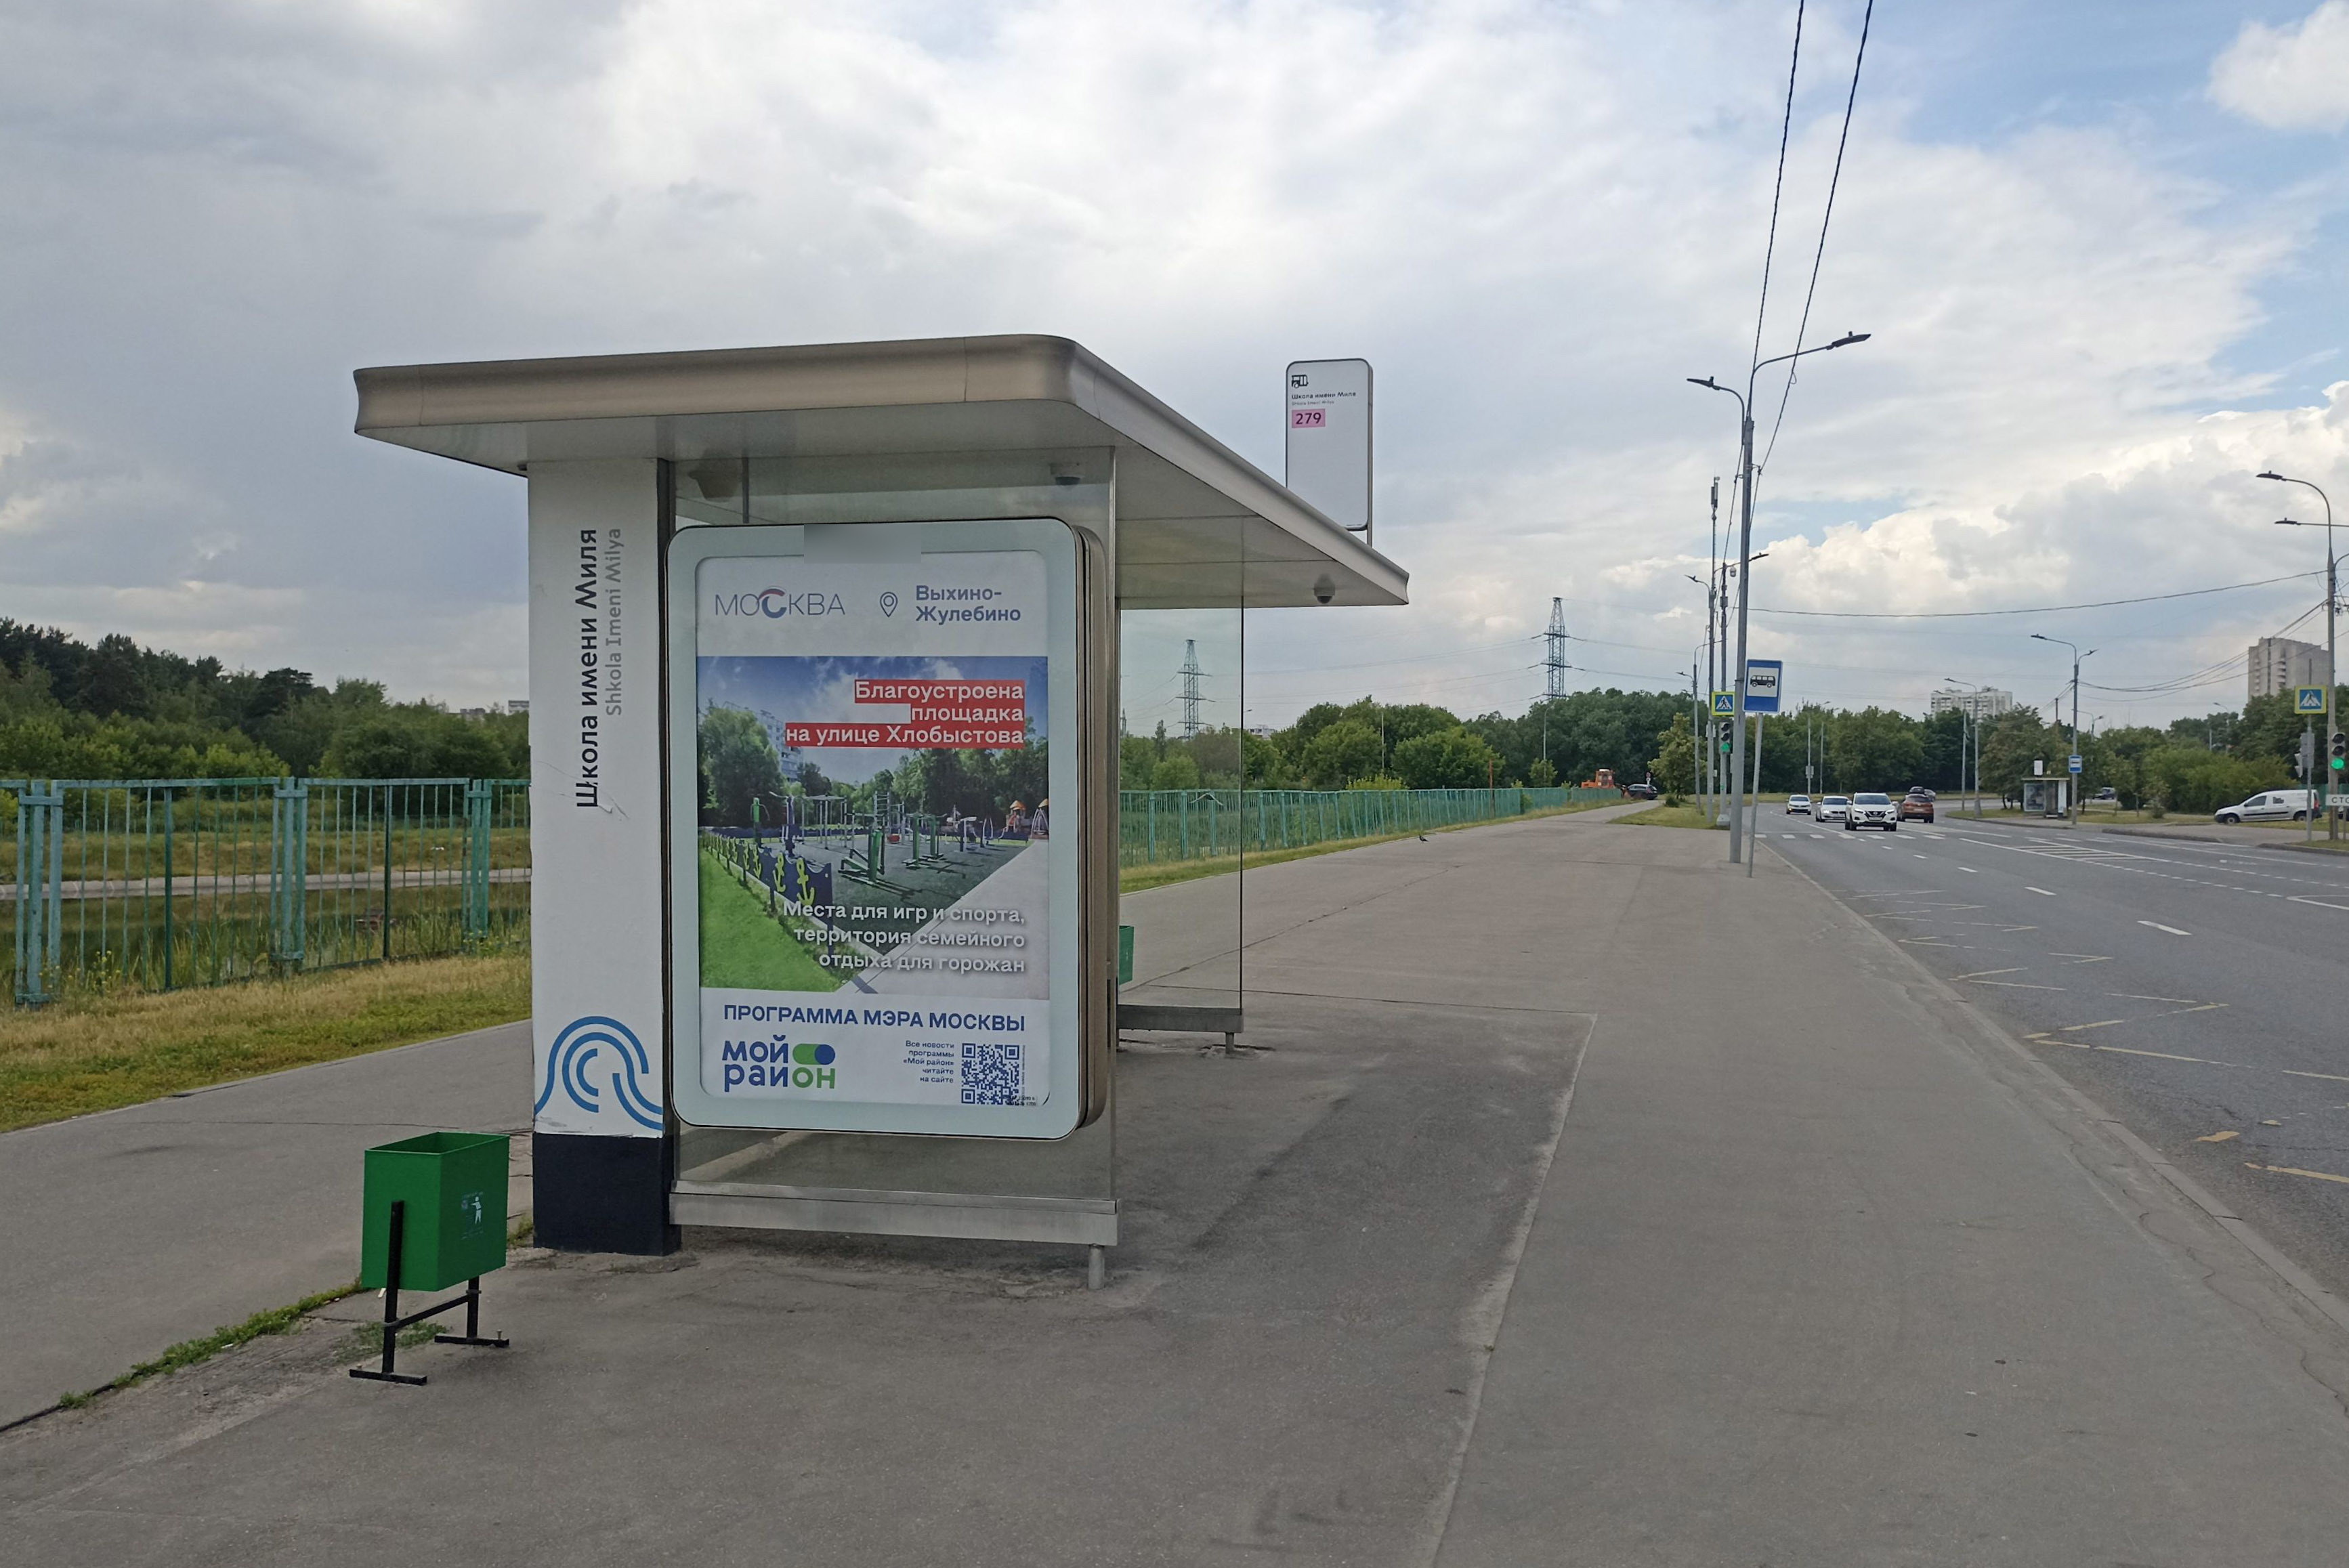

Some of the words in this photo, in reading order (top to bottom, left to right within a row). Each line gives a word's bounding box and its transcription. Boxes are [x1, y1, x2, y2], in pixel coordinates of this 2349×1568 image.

[1296, 412, 1321, 425] 279
[605, 528, 625, 583] Milya
[575, 529, 597, 609] Миля
[715, 586, 846, 619] МОСКВА
[916, 585, 1002, 601] Выхино-
[605, 589, 622, 647] Imeni
[916, 606, 1021, 624] Жулебино
[581, 618, 597, 706] имени
[606, 652, 622, 716] Shkola
[855, 681, 1024, 704] Благоустроена
[911, 705, 1024, 722] площадка
[786, 729, 810, 742] на
[816, 728, 881, 746] улице
[886, 725, 1024, 744] Хлобыстова
[576, 715, 599, 807] Школа
[783, 901, 846, 918] Места
[851, 907, 888, 920] для
[893, 906, 927, 923] игр
[933, 908, 945, 920] и
[950, 909, 1025, 925] спорта,
[793, 929, 911, 946] территория
[916, 930, 1025, 948] семейного
[819, 953, 892, 969] отдыха
[897, 956, 933, 970] для
[938, 958, 1025, 974] горожан
[724, 1004, 858, 1024] ПРОГРАММА
[864, 1009, 923, 1027] МЭРА
[929, 1012, 1025, 1032] МОСКВЫ
